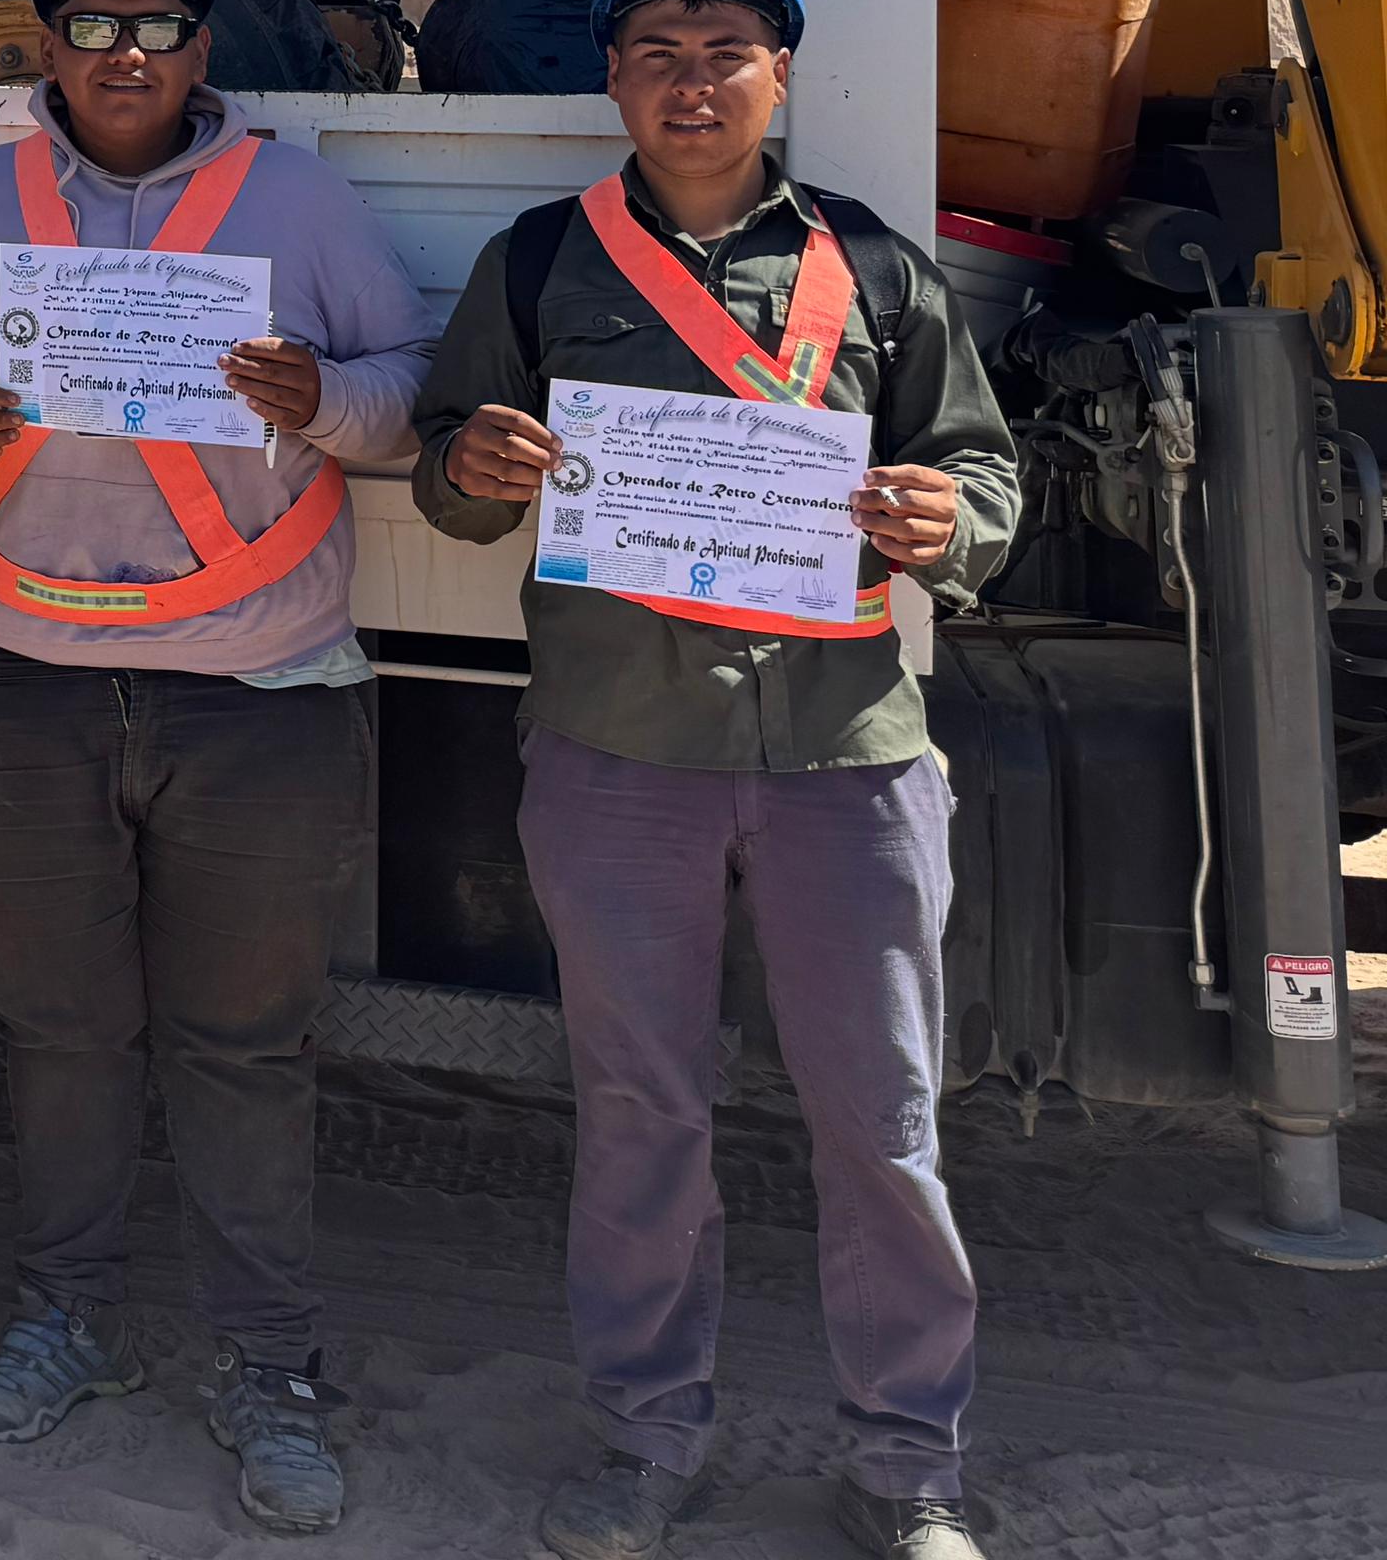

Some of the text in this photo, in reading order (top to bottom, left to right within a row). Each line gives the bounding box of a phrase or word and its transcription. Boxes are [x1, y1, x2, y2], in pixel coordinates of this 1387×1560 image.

[56, 252, 130, 286] Certificado
[45, 324, 238, 354] Operador de Retro Excavad
[59, 371, 236, 401] Certificado de Aptitud Profesional
[619, 397, 708, 432] Certificado
[714, 403, 732, 421] de
[602, 470, 681, 490] Operador
[685, 479, 703, 493] de
[707, 482, 756, 500] Retro
[614, 525, 824, 570] Certificado de Aptitud Profesional
[1284, 961, 1329, 972] PELIGRO
